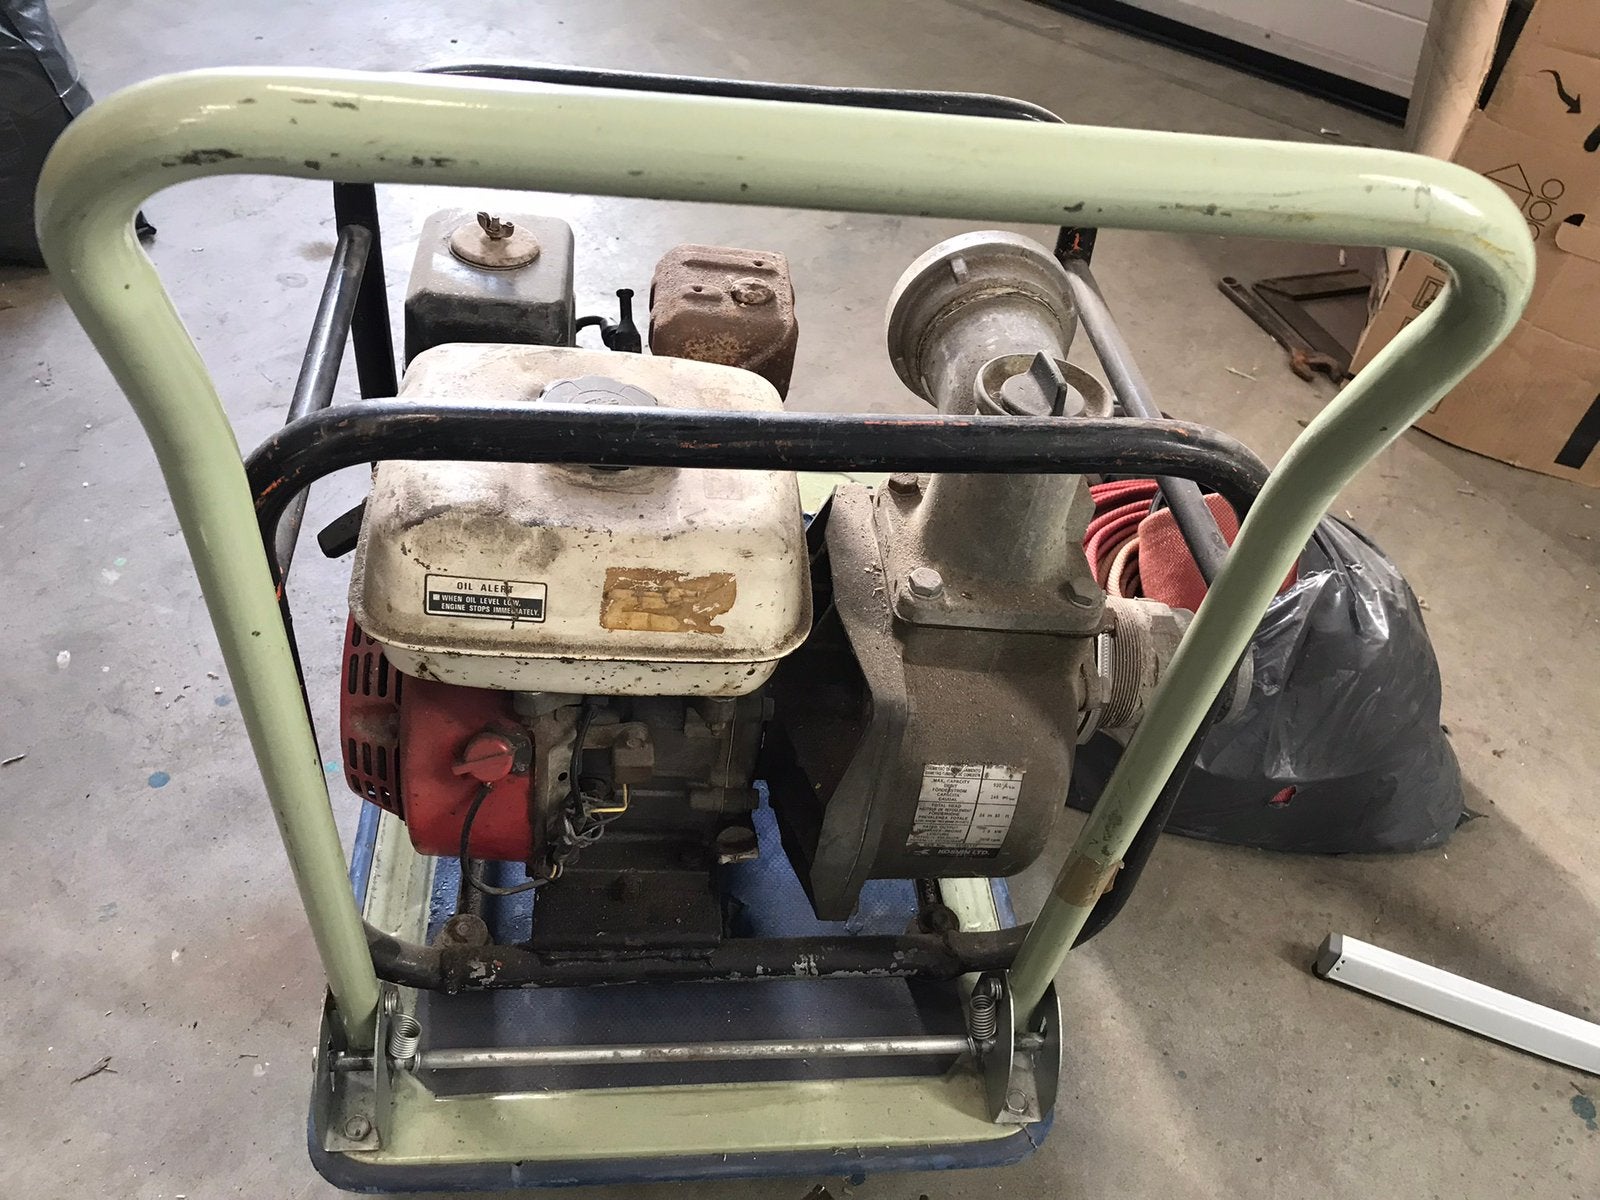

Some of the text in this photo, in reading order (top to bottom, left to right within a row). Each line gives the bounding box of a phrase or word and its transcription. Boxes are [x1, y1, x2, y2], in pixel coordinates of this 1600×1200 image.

[456, 581, 473, 591] OIL
[441, 594, 462, 603] WHEN
[465, 596, 477, 604] OIL
[479, 597, 500, 605] LEVEL
[441, 603, 466, 611] ENGINE
[469, 604, 491, 613] STOPS
